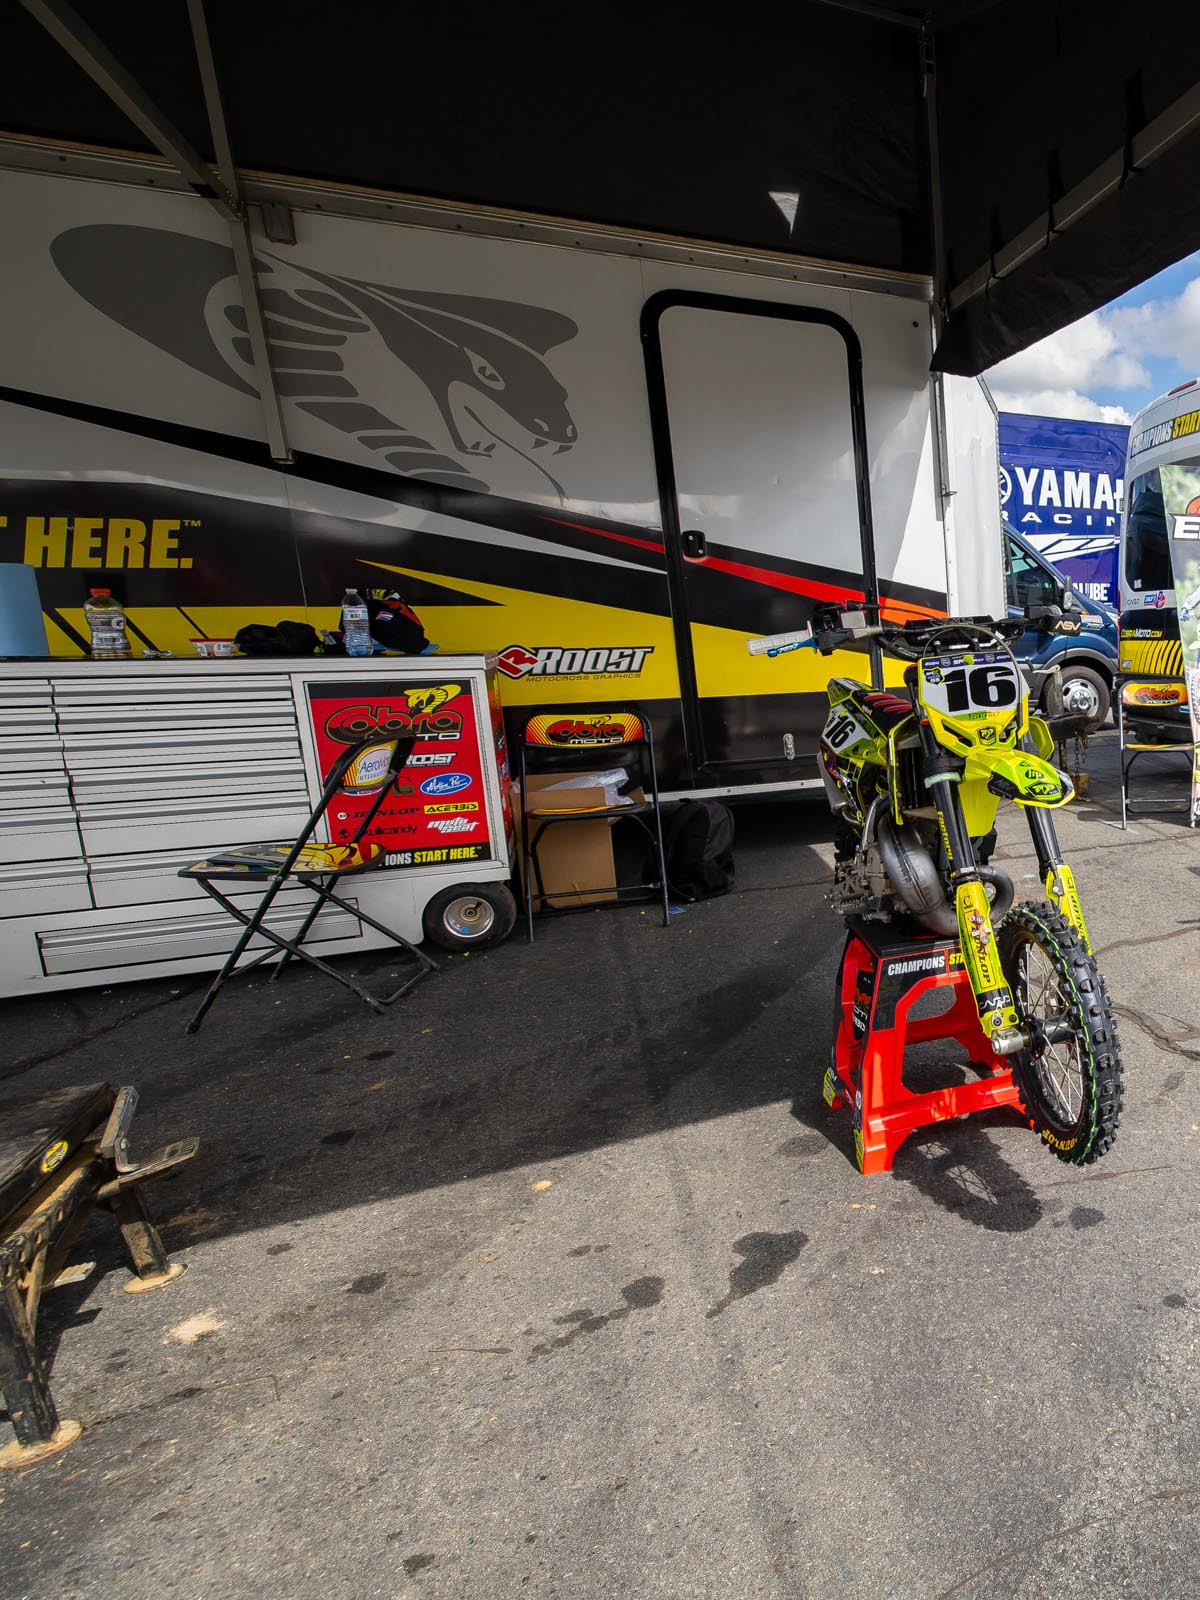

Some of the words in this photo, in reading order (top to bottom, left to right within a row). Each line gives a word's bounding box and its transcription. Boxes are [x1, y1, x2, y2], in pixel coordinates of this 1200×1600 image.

[1055, 621, 1081, 631] ASV
[530, 648, 653, 676] ROOST
[941, 666, 1017, 712] 16
[546, 719, 625, 744] Cobra
[825, 717, 855, 748] 16
[414, 851, 447, 863] START
[888, 956, 945, 976] CHAMPIONS
